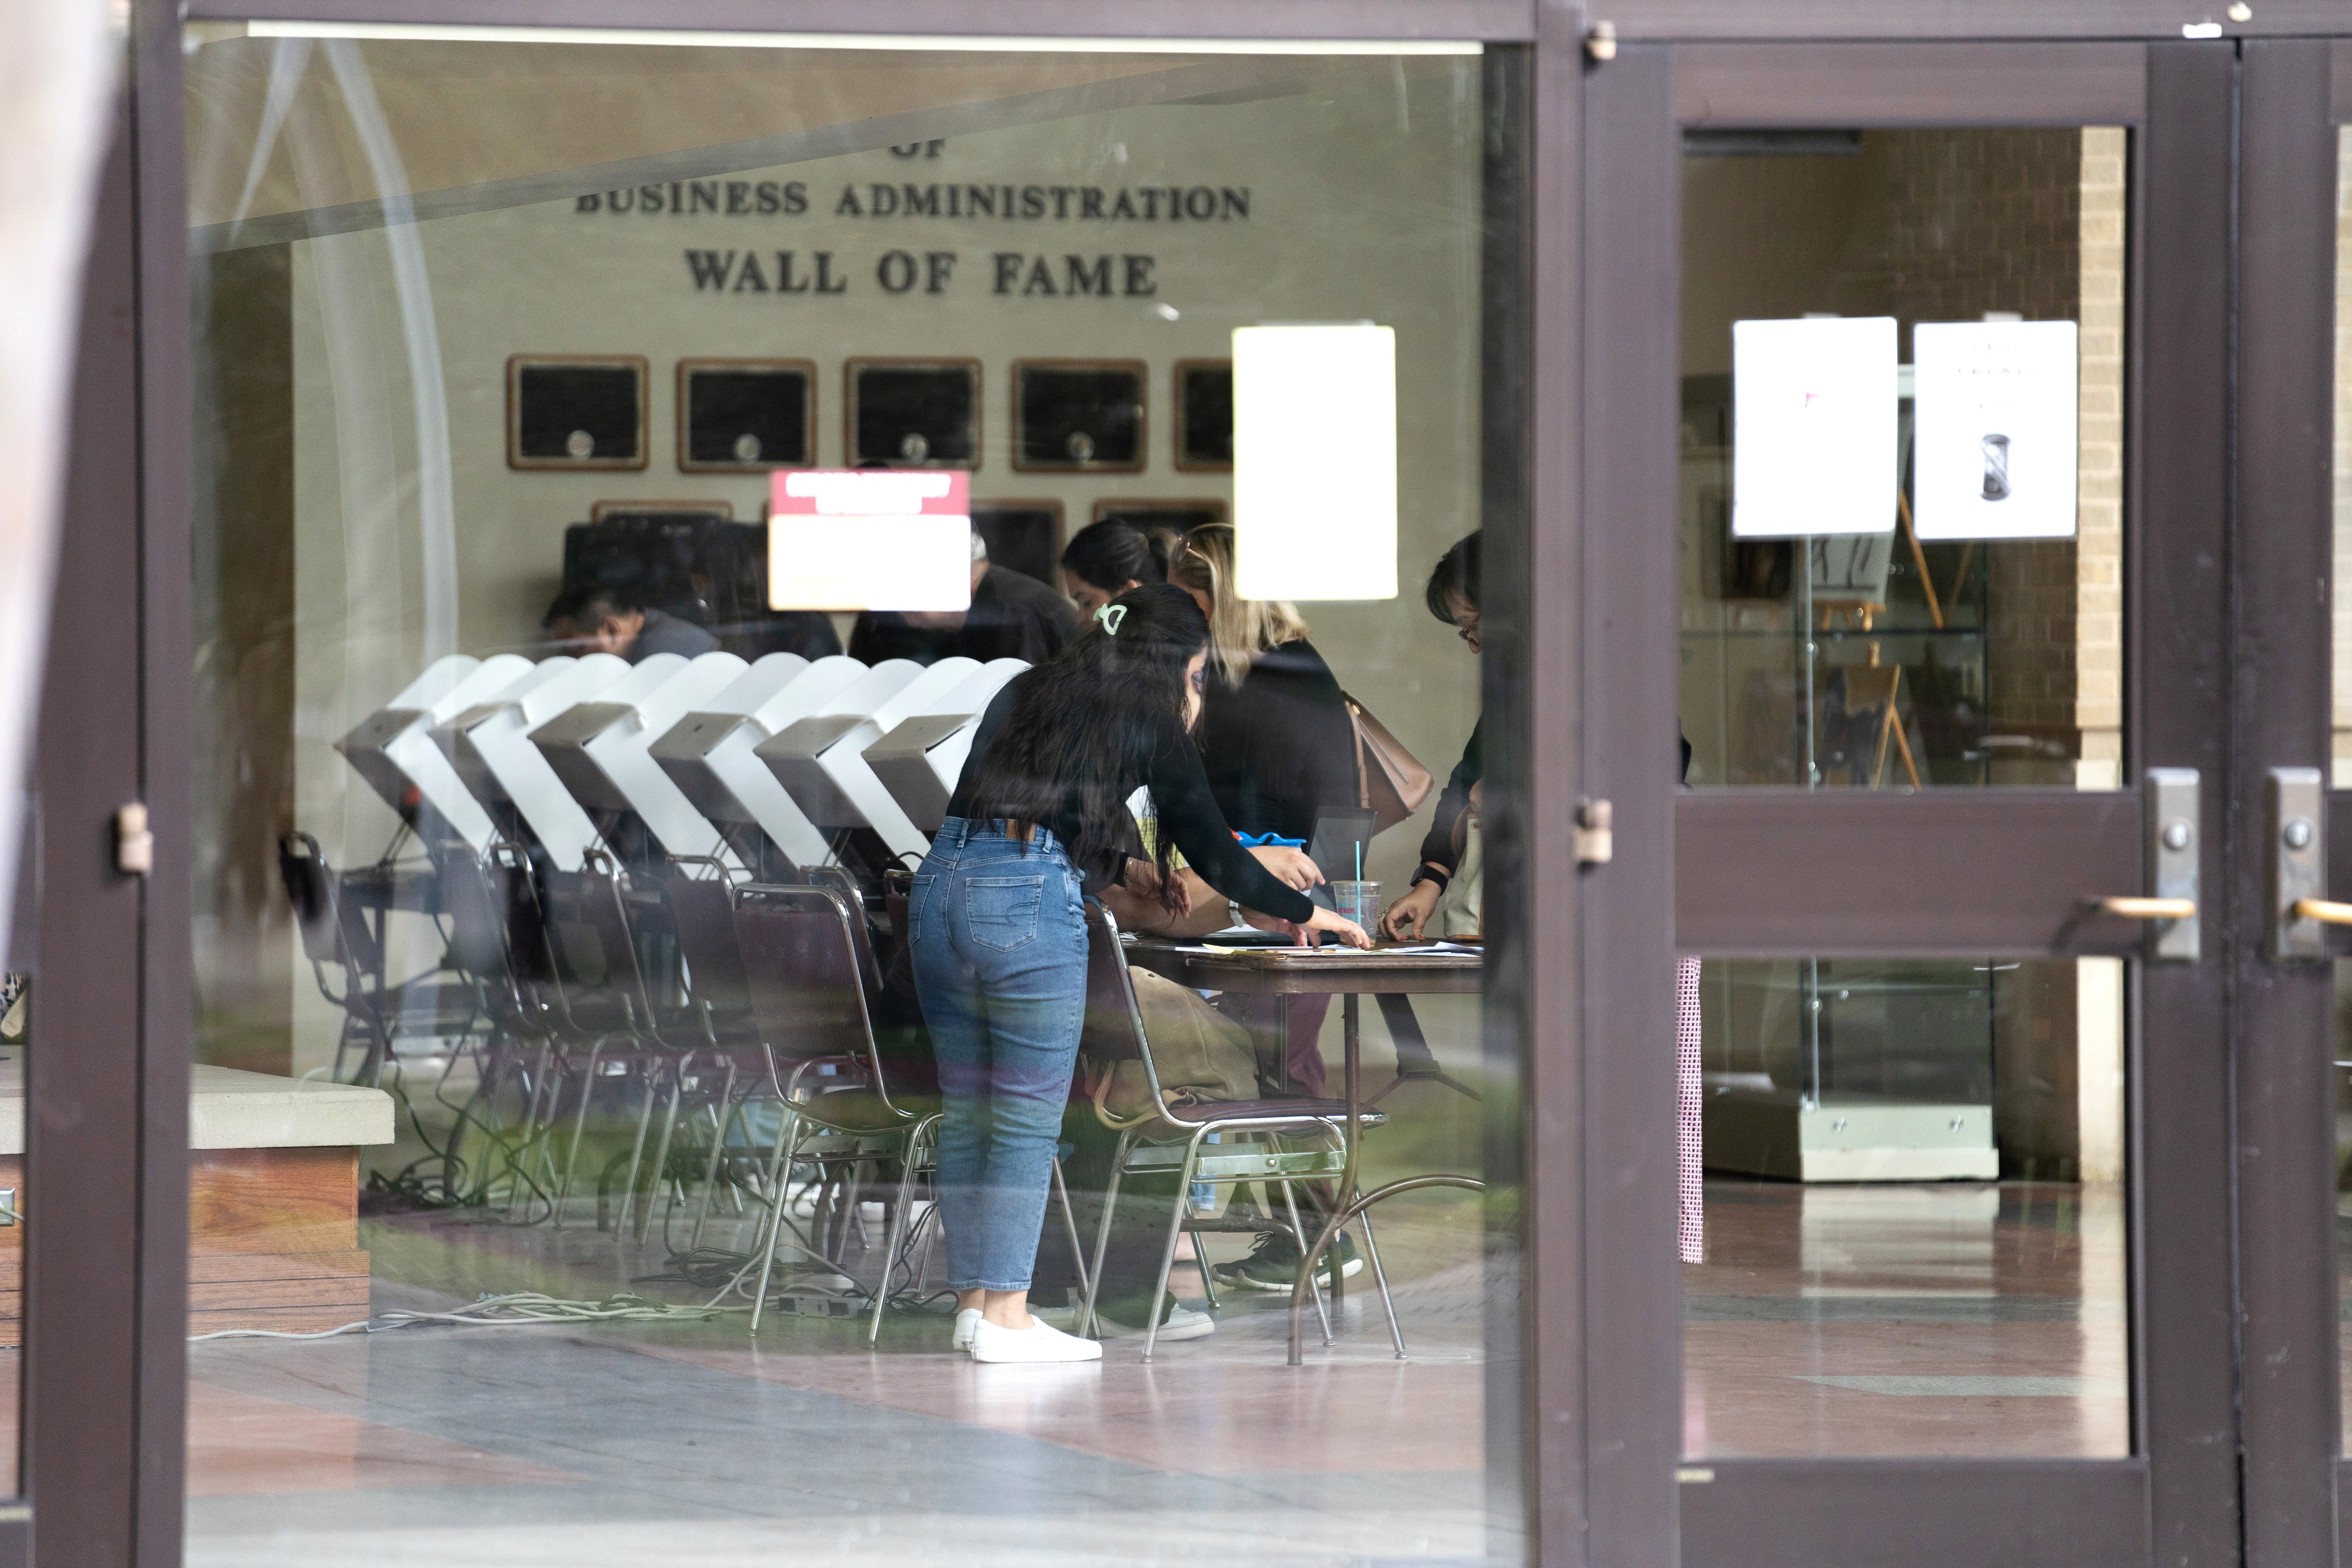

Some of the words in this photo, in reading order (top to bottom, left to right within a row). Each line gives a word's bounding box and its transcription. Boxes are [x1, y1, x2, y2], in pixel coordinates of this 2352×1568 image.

[575, 181, 808, 215] BUSINESS
[835, 183, 1250, 221] ADMINISTRATION
[684, 248, 847, 295] WALL
[877, 249, 957, 295] OF
[992, 253, 1157, 297] FAME
